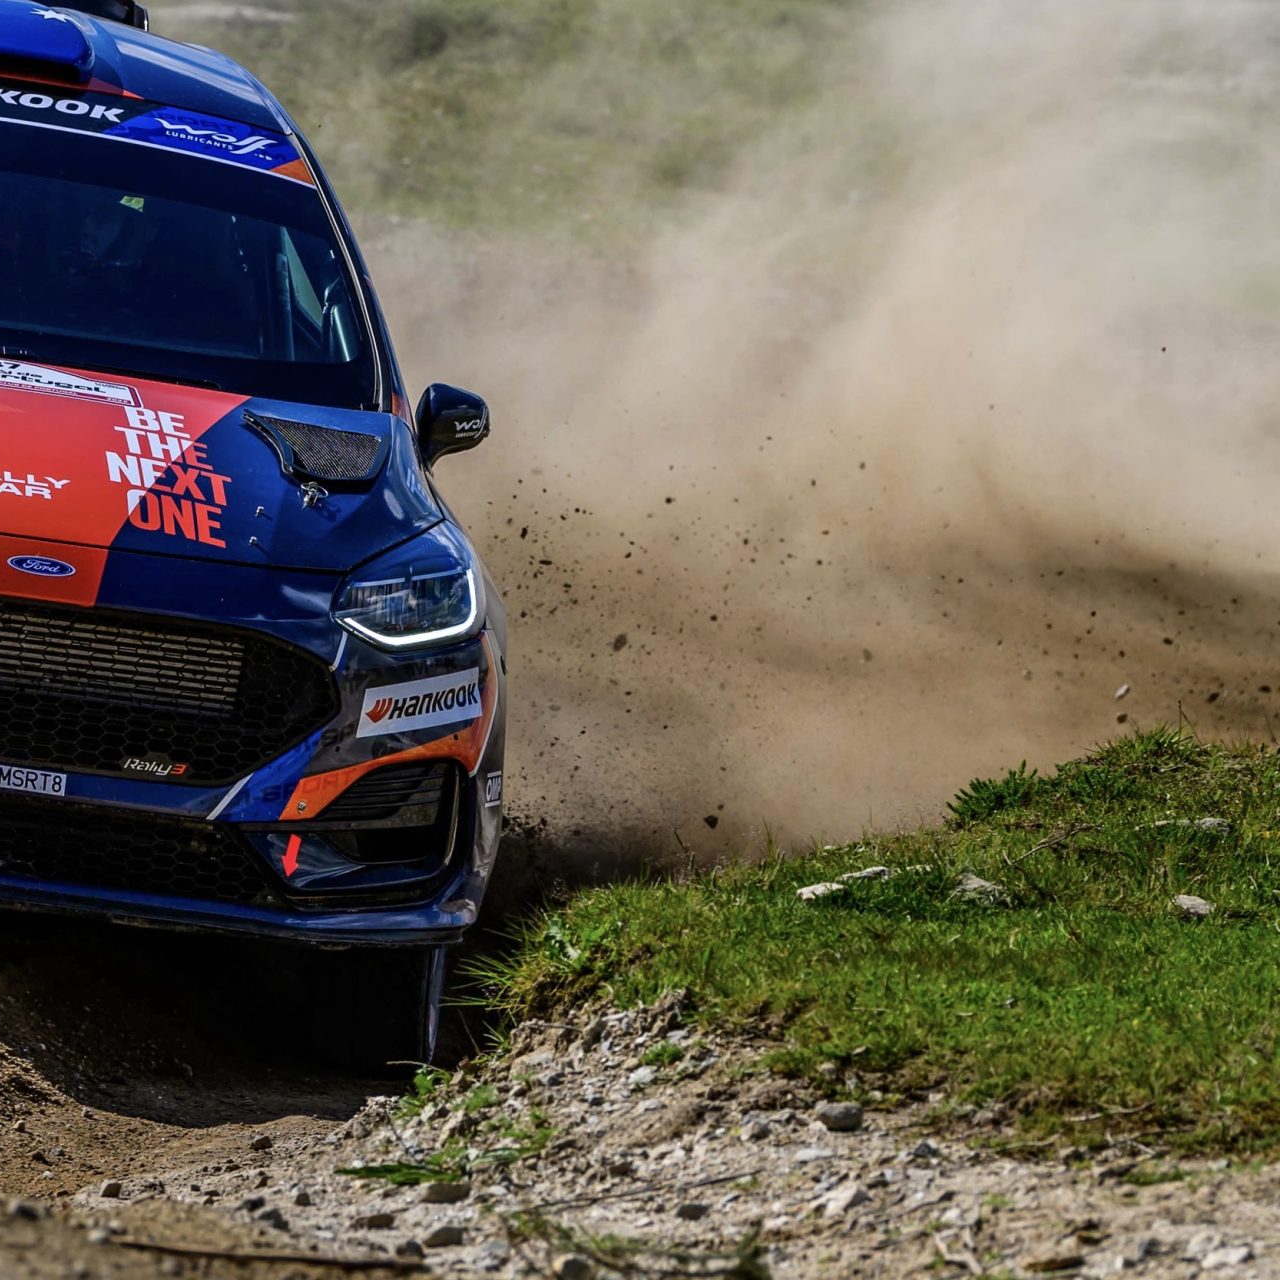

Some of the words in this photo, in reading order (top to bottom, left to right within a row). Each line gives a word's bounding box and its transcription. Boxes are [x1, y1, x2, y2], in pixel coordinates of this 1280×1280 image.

[165, 130, 233, 150] LUBRICANTS
[124, 406, 191, 438] BE
[114, 426, 214, 470] THE
[105, 451, 232, 506] NEXT
[126, 489, 227, 549] ONE
[22, 559, 61, 573] Ford
[485, 776, 502, 802] OMP
